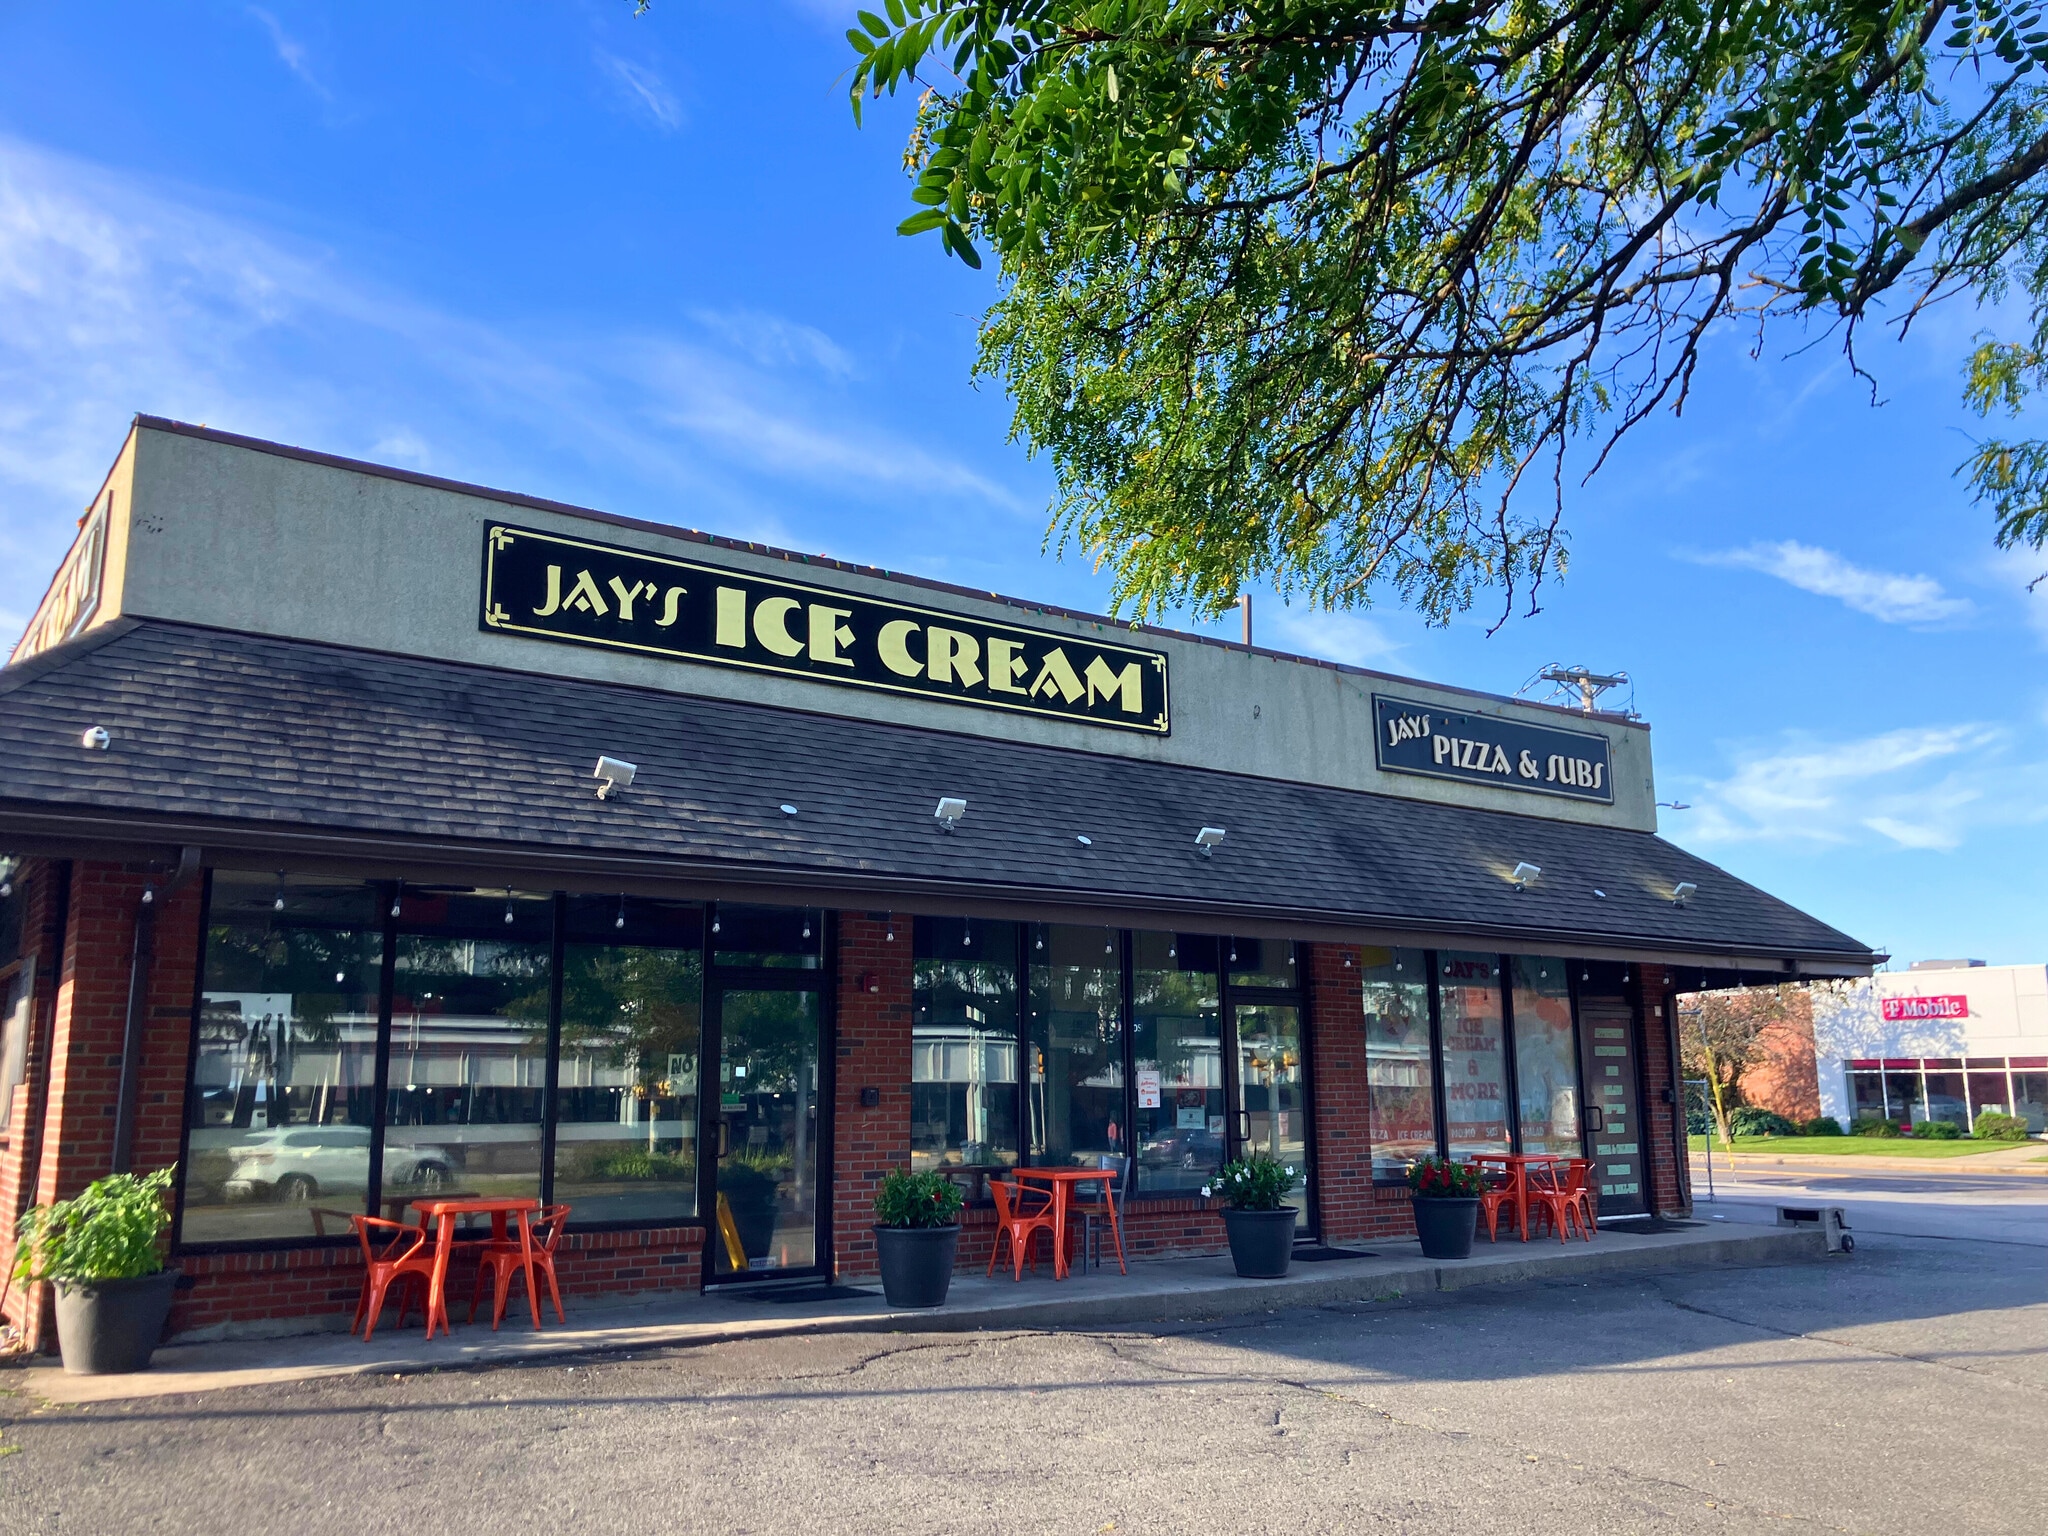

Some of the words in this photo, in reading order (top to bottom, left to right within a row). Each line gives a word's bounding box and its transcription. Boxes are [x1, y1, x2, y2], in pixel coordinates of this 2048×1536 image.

[532, 563, 687, 627] JAY'S
[715, 586, 856, 668] ICE
[876, 619, 1144, 715] CREAM
[1432, 733, 1512, 775] PIZZA
[1518, 748, 1540, 780] &
[1545, 753, 1605, 790] SUBS
[671, 1057, 694, 1074] NO
[1450, 1082, 1500, 1100] MORE
